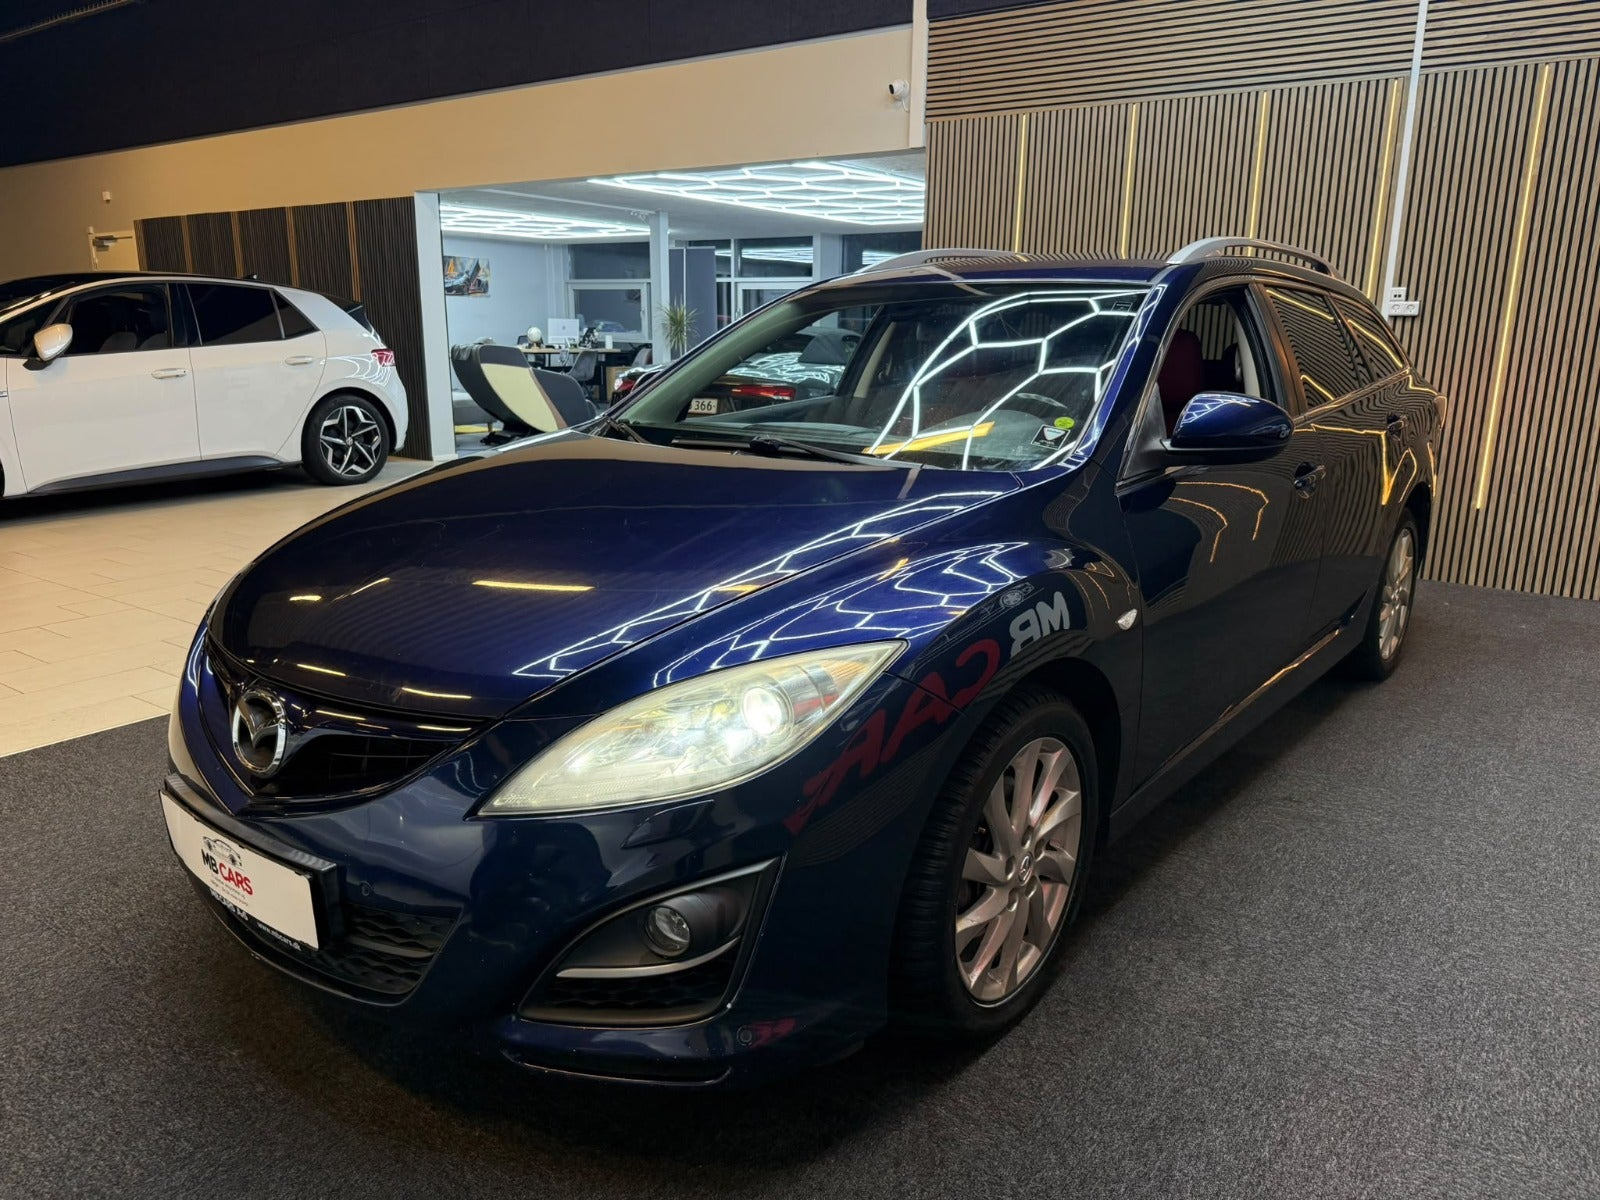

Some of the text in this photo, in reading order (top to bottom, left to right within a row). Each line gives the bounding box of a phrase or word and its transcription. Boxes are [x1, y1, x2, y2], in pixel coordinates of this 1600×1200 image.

[694, 400, 712, 411] 366
[201, 848, 219, 875] MB
[219, 862, 254, 896] CARS
